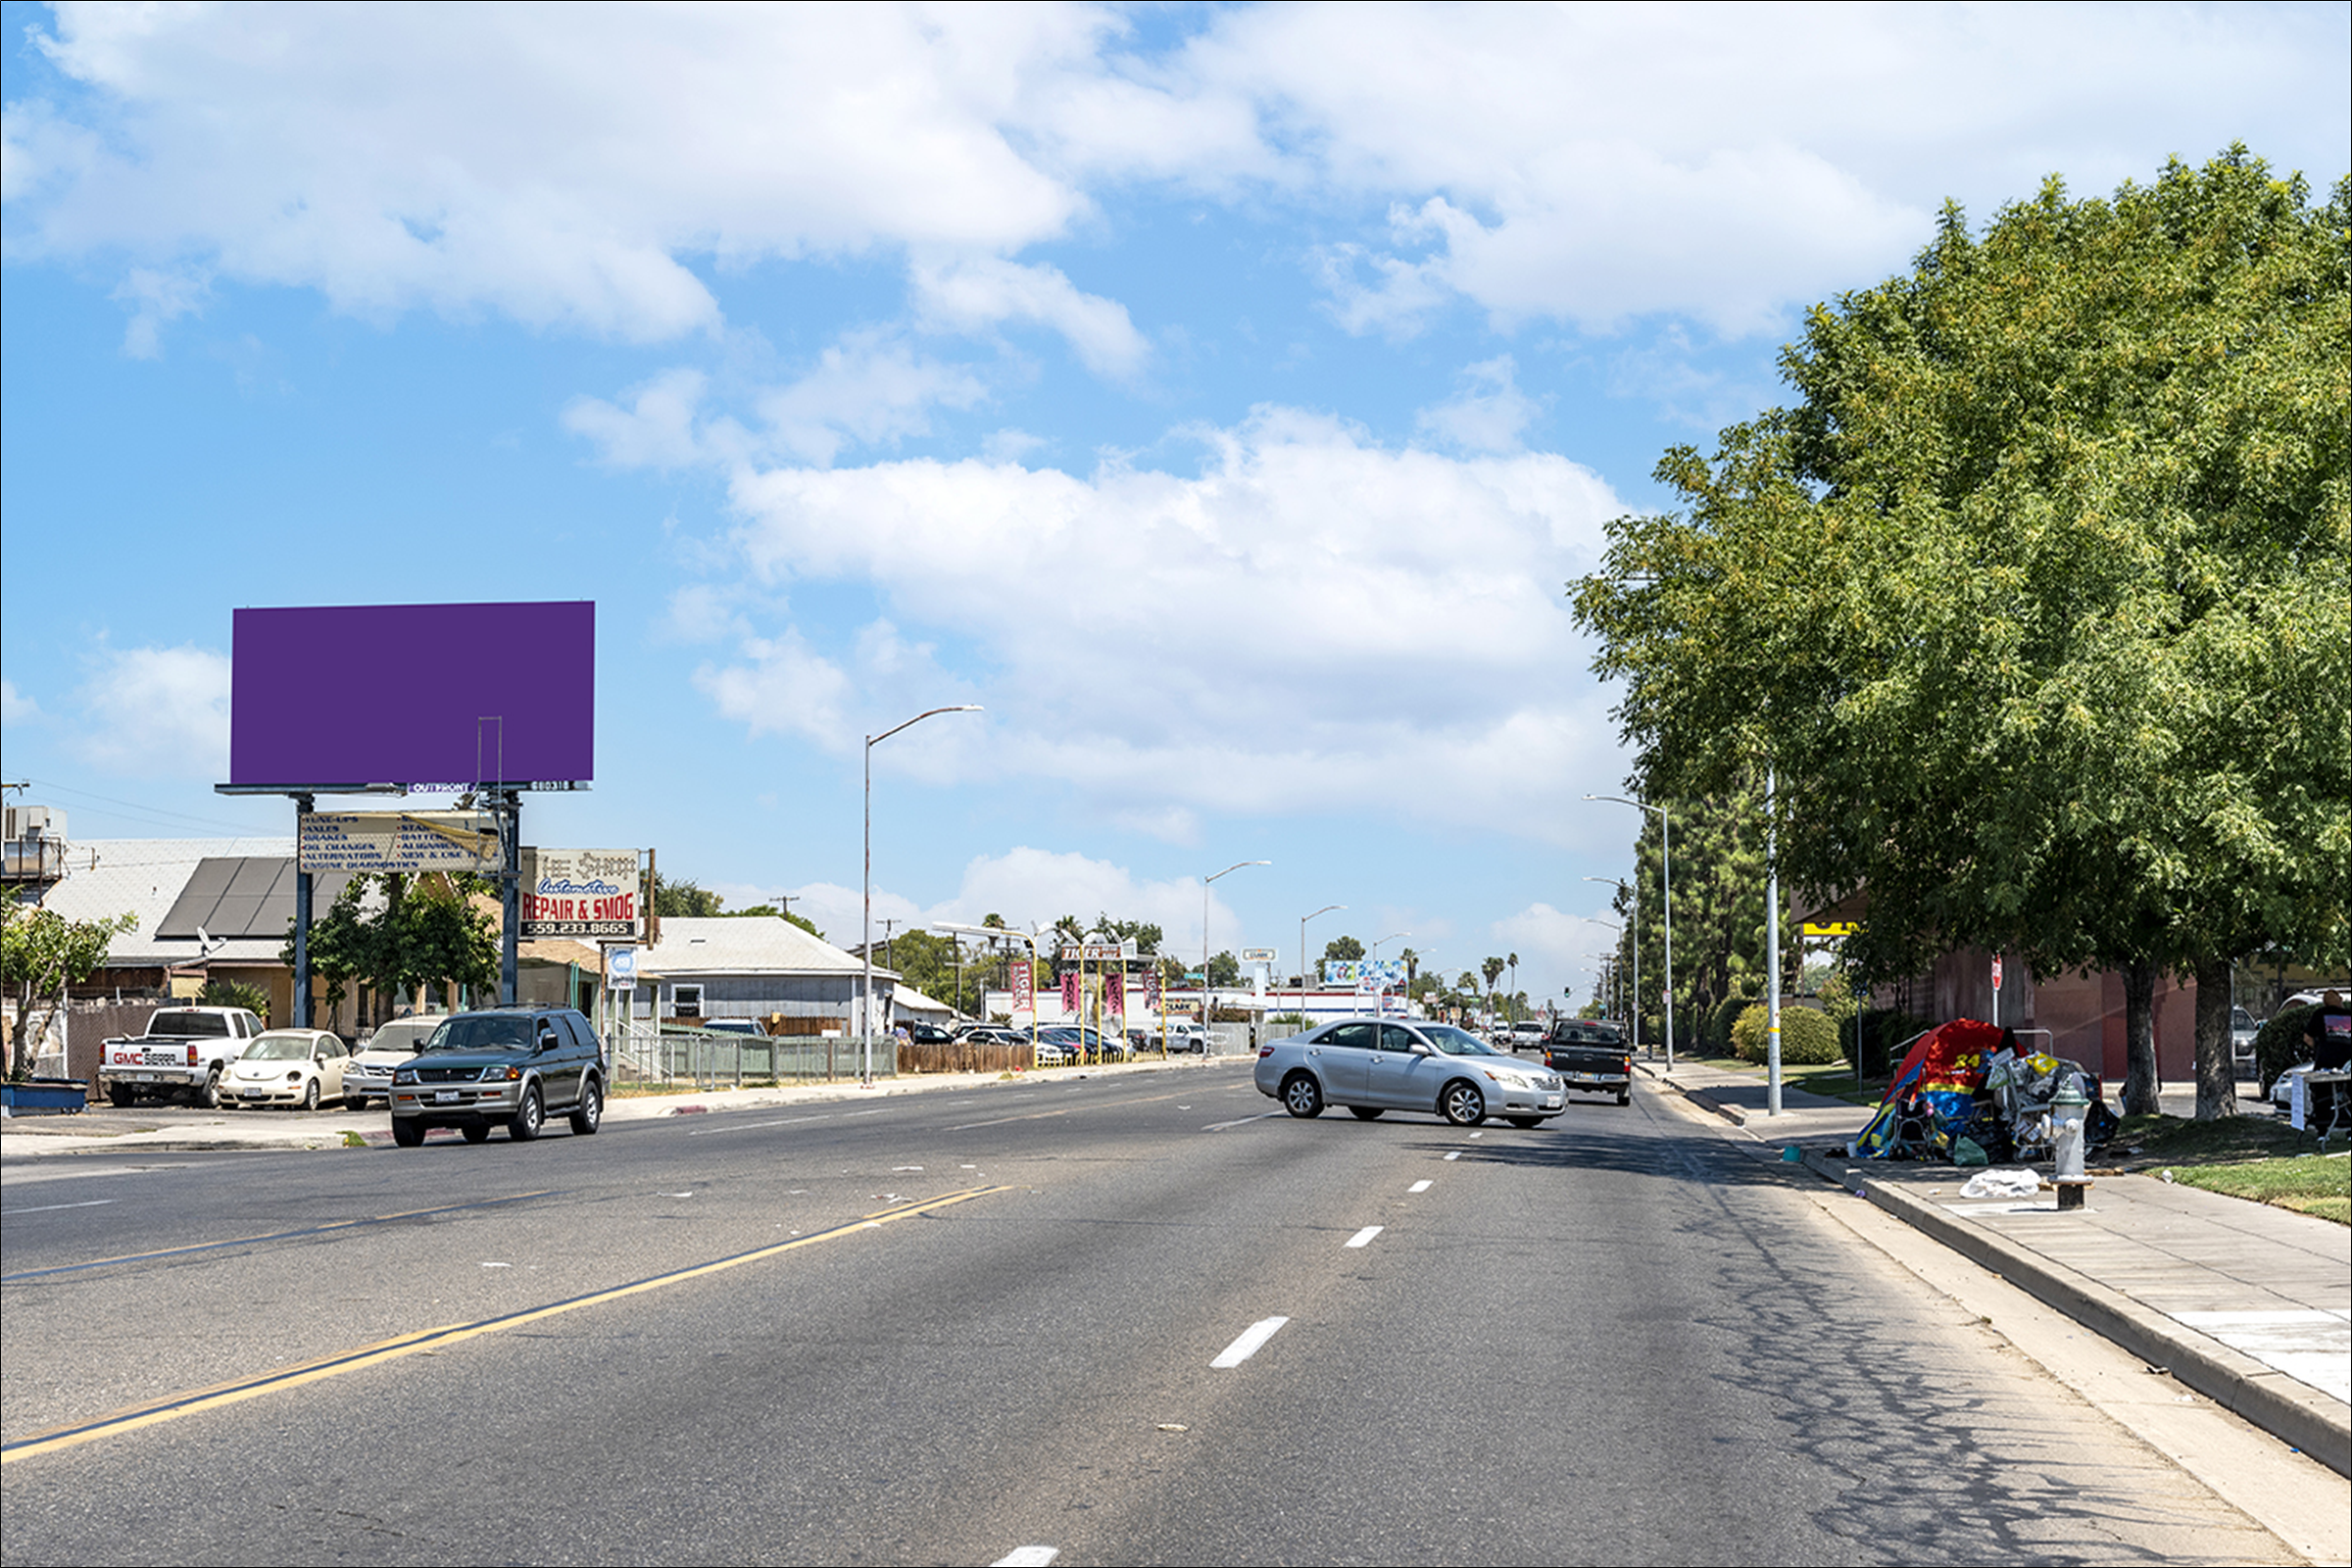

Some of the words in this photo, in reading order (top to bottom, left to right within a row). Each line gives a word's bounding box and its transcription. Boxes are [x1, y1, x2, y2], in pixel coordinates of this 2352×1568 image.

[413, 783, 471, 793] OUTFRONT
[304, 833, 349, 842] BRAKES
[325, 843, 376, 852] CHANGES
[304, 861, 342, 870] ENGINE
[537, 877, 619, 895] Automotive
[522, 892, 573, 920] REPAIR
[577, 900, 589, 920] &
[594, 892, 634, 920] SMOG
[527, 922, 628, 935] 559.233.8665
[1018, 963, 1031, 1009] TIGER
[114, 1053, 143, 1064] GMC
